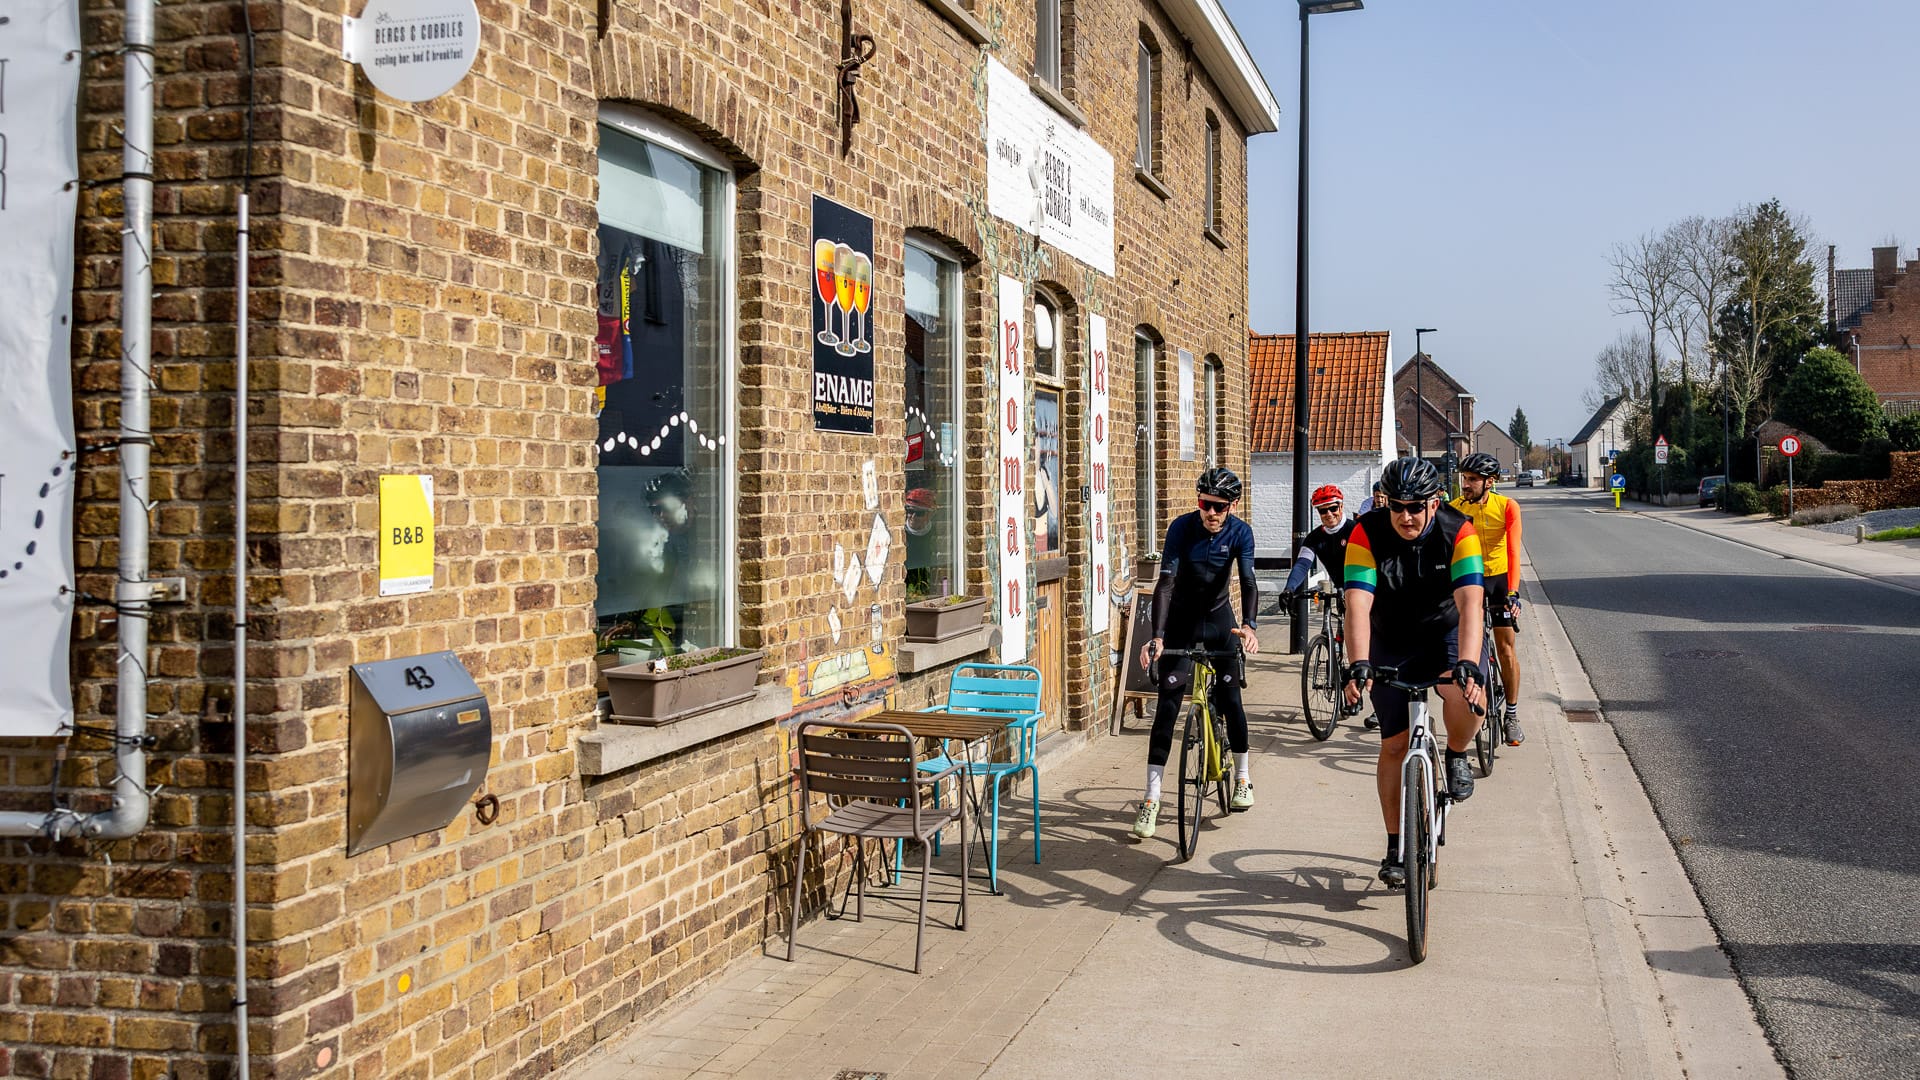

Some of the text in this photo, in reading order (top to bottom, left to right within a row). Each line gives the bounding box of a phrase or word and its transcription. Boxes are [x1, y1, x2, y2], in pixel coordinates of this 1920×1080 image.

[375, 26, 405, 44] BERGS
[421, 21, 463, 40] COBBLES
[375, 54, 397, 68] cycling
[432, 48, 463, 61] breakfast
[1044, 149, 1065, 191] BERGS
[1045, 184, 1072, 228] COBBLES
[815, 371, 872, 407] ENAME
[1003, 319, 1022, 619] Roman
[1093, 349, 1107, 596] Roman
[393, 526, 424, 545] B&B
[405, 665, 435, 691] 43
